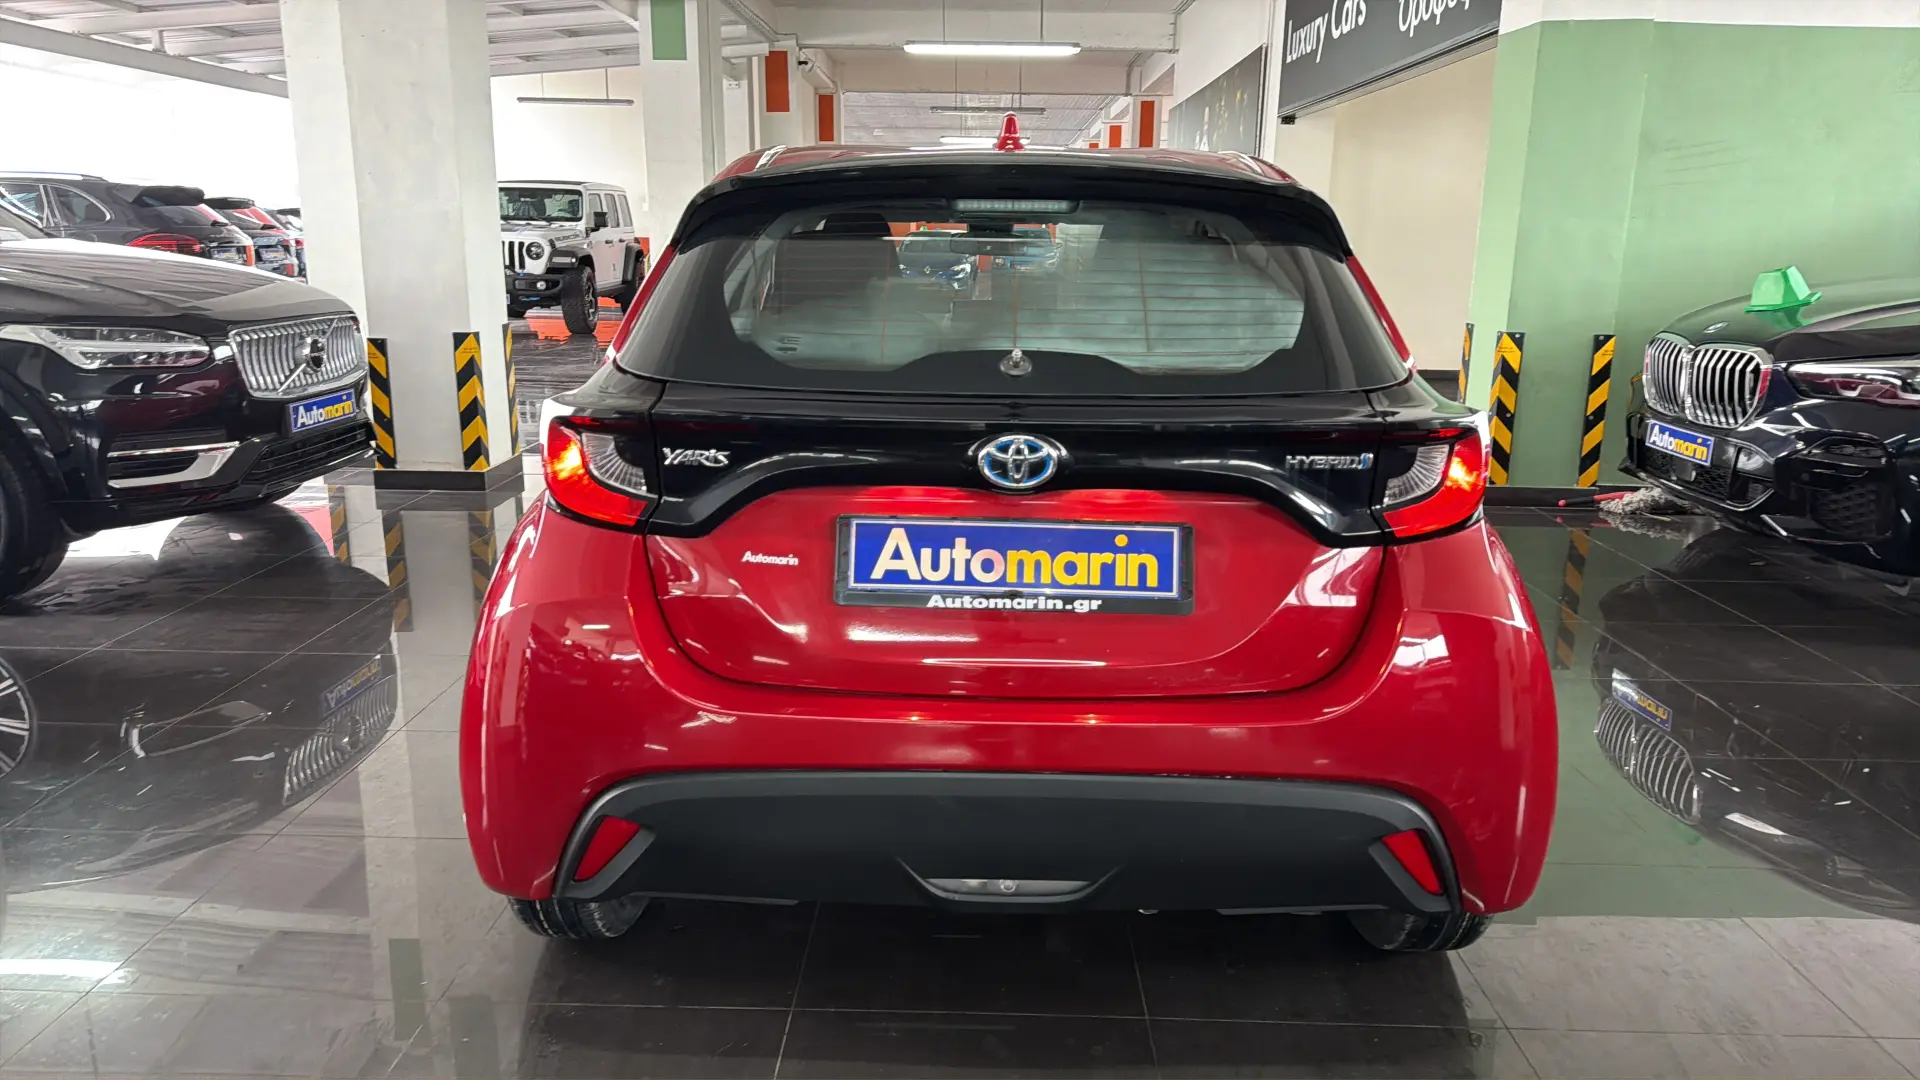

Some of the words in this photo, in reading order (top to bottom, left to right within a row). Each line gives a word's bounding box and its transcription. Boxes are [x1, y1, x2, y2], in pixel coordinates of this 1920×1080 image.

[1286, 12, 1329, 63] Luxury
[1331, 0, 1367, 39] Cars
[297, 395, 353, 428] Automarin
[1650, 425, 1708, 461] Automarin
[1285, 455, 1360, 469] HYBRID
[741, 550, 799, 566] Automarin
[870, 527, 1158, 588] Automarin
[926, 594, 1102, 613] Automarin.gr
